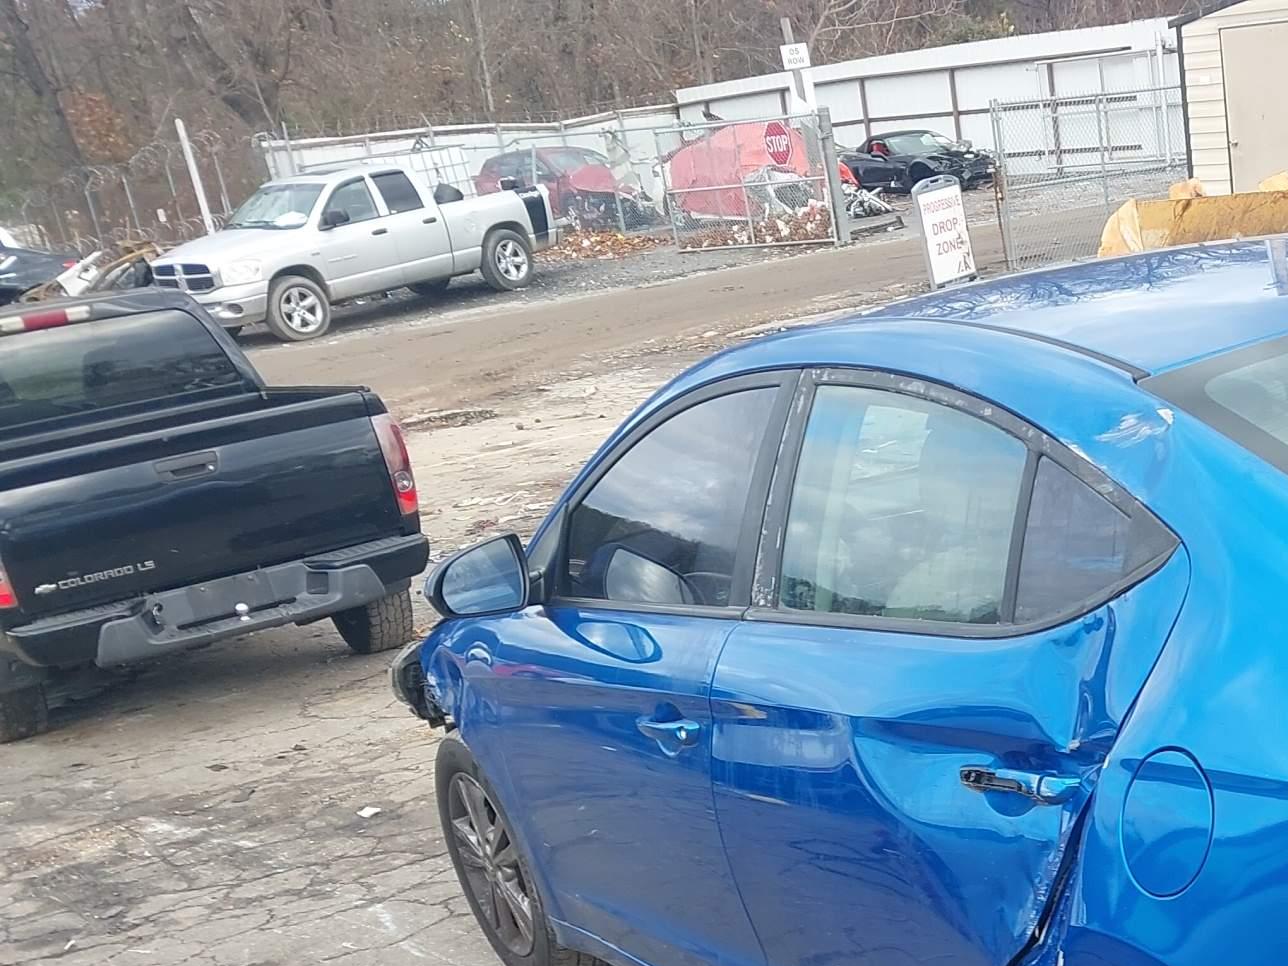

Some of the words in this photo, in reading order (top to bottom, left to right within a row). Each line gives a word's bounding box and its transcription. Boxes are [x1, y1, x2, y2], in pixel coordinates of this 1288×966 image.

[766, 134, 788, 153] STOP
[931, 217, 959, 236] DROP
[935, 239, 964, 256] ZONE
[58, 565, 134, 590] COLORADO
[136, 560, 157, 571] LS
